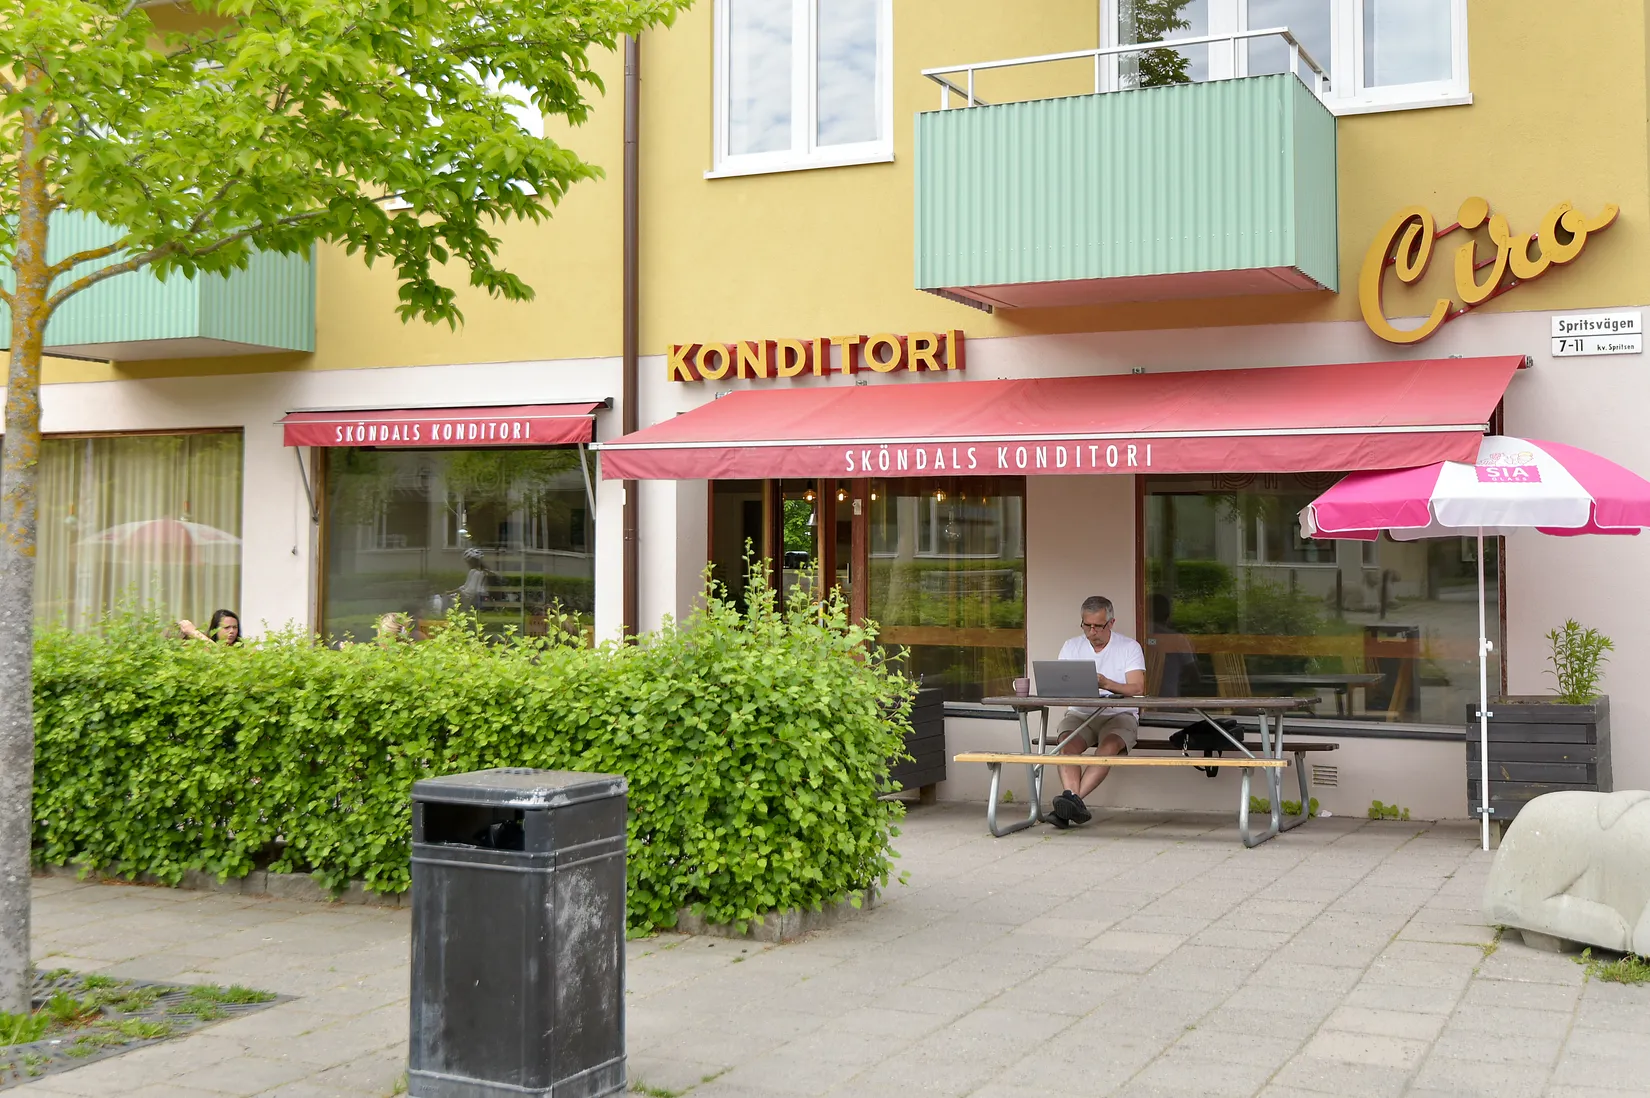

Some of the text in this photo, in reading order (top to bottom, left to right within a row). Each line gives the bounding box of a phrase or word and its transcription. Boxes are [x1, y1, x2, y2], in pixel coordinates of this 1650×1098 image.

[1359, 196, 1620, 344] Ciro
[1559, 318, 1633, 333] Spritsvägen
[1559, 339, 1584, 352] 7-11
[1608, 343, 1634, 352] Spritsen
[667, 329, 965, 382] KONDITORI
[336, 421, 531, 442] SKÖNDALS KONDITORI
[845, 444, 1152, 472] SKÖNDALS KONDITORI
[1486, 467, 1529, 477] SIA
